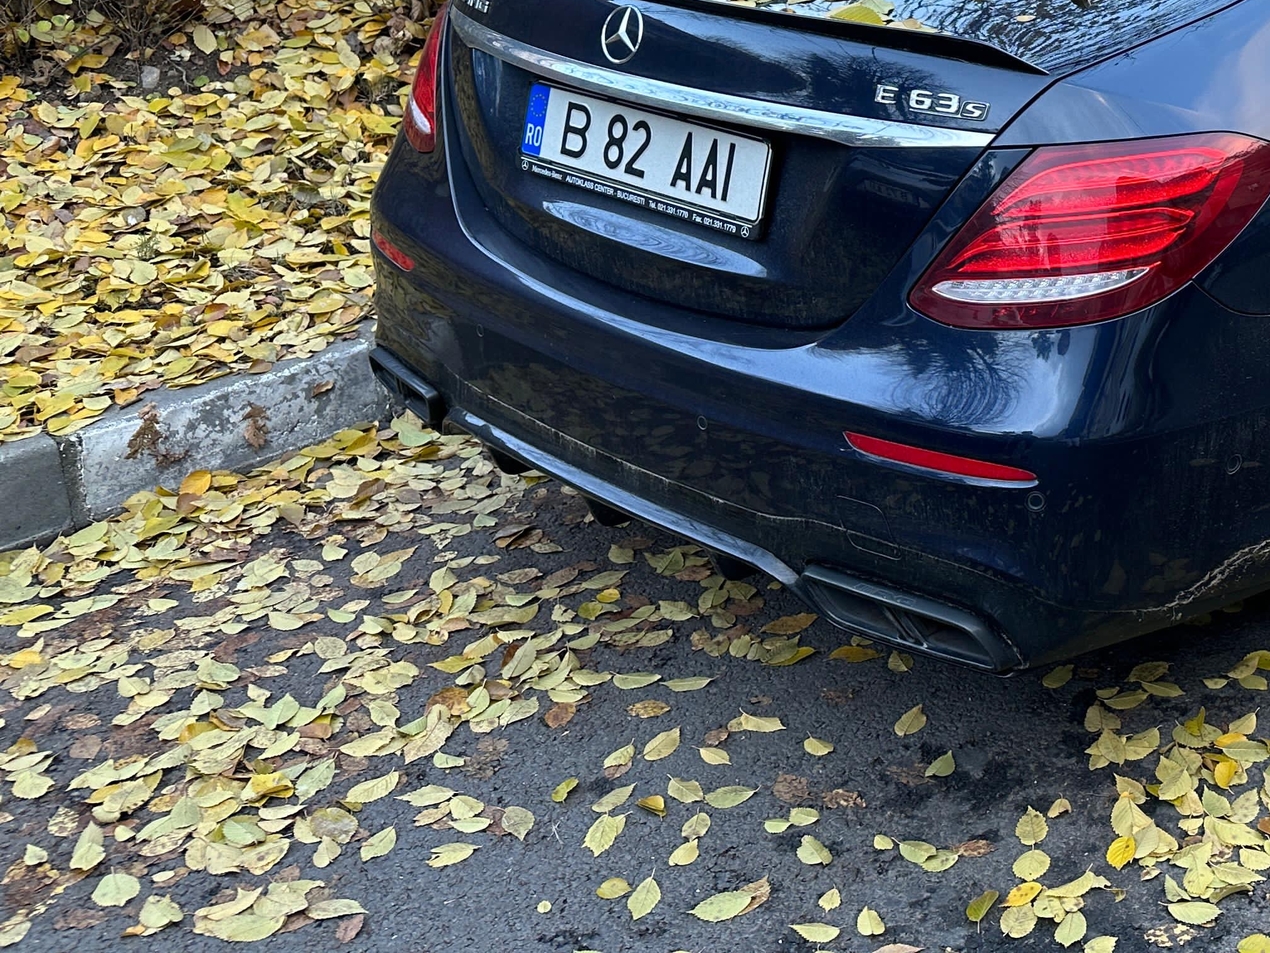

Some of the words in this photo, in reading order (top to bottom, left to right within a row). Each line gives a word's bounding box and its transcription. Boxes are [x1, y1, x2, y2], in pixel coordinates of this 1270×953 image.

[874, 84, 899, 104] E
[525, 123, 542, 147] RO
[560, 101, 592, 159] B
[603, 114, 652, 179] 82
[669, 131, 737, 202] AAI
[565, 175, 594, 190] AUTOKLASS
[594, 184, 614, 195] CENTER
[616, 190, 646, 206] BUCURESTI
[648, 200, 657, 210] Tel.
[657, 203, 689, 219] 021.331.1770
[703, 217, 737, 233] 021.331.1779
